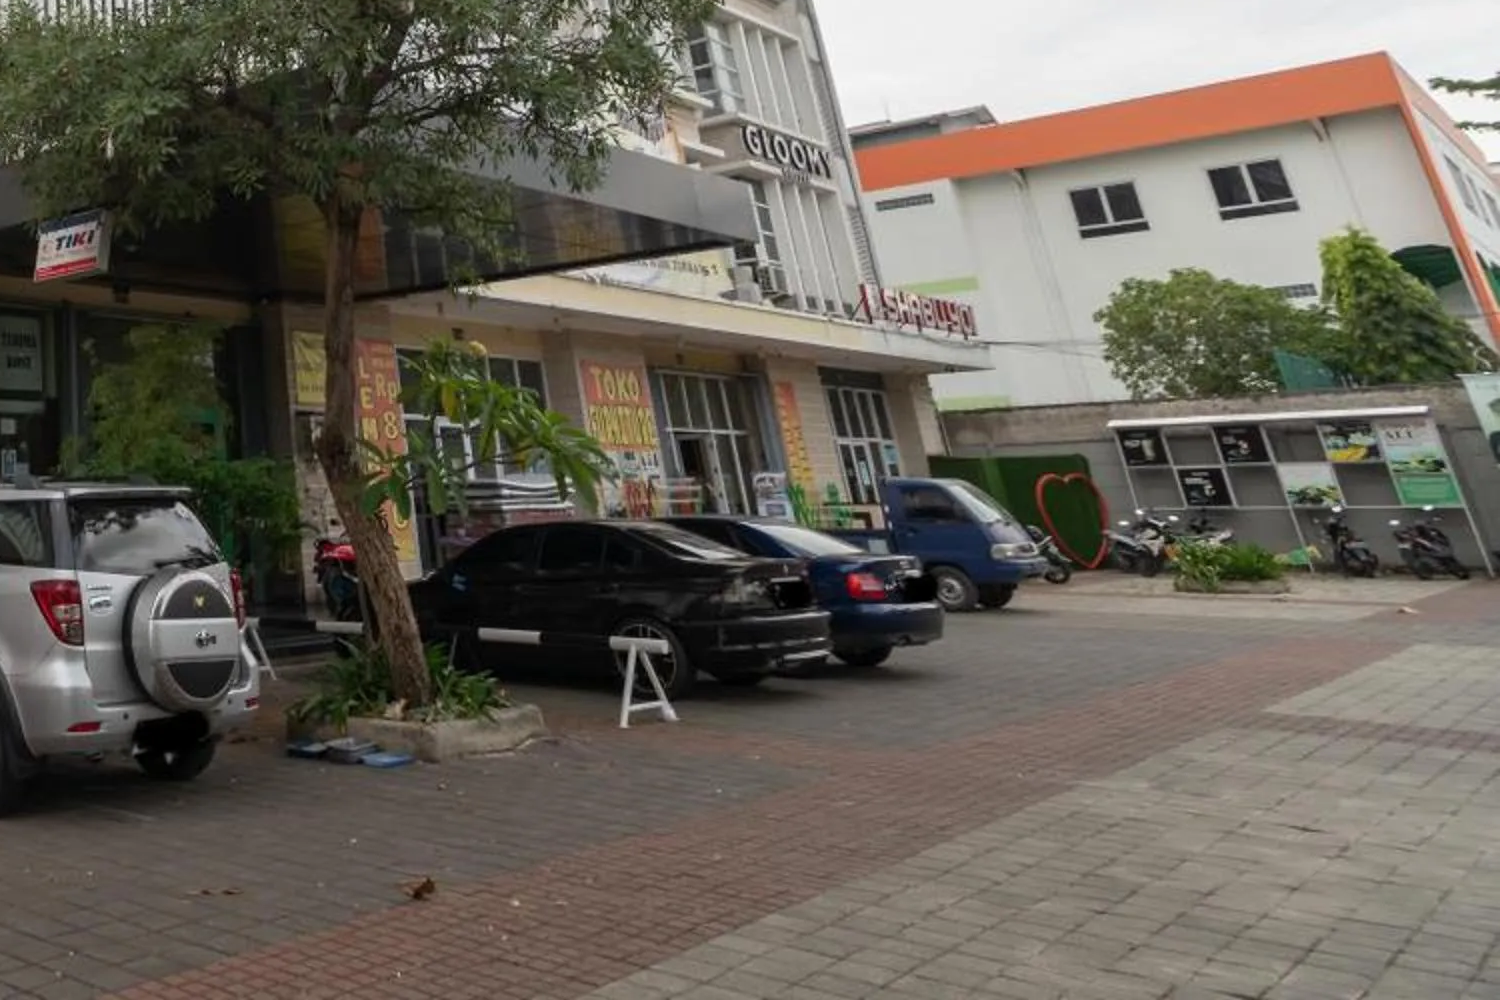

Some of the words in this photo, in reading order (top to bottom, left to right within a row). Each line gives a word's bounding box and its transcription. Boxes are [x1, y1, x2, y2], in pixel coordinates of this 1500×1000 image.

[742, 126, 831, 180] GLOOMY
[56, 229, 95, 251] TIKI
[590, 365, 640, 402] TOKO
